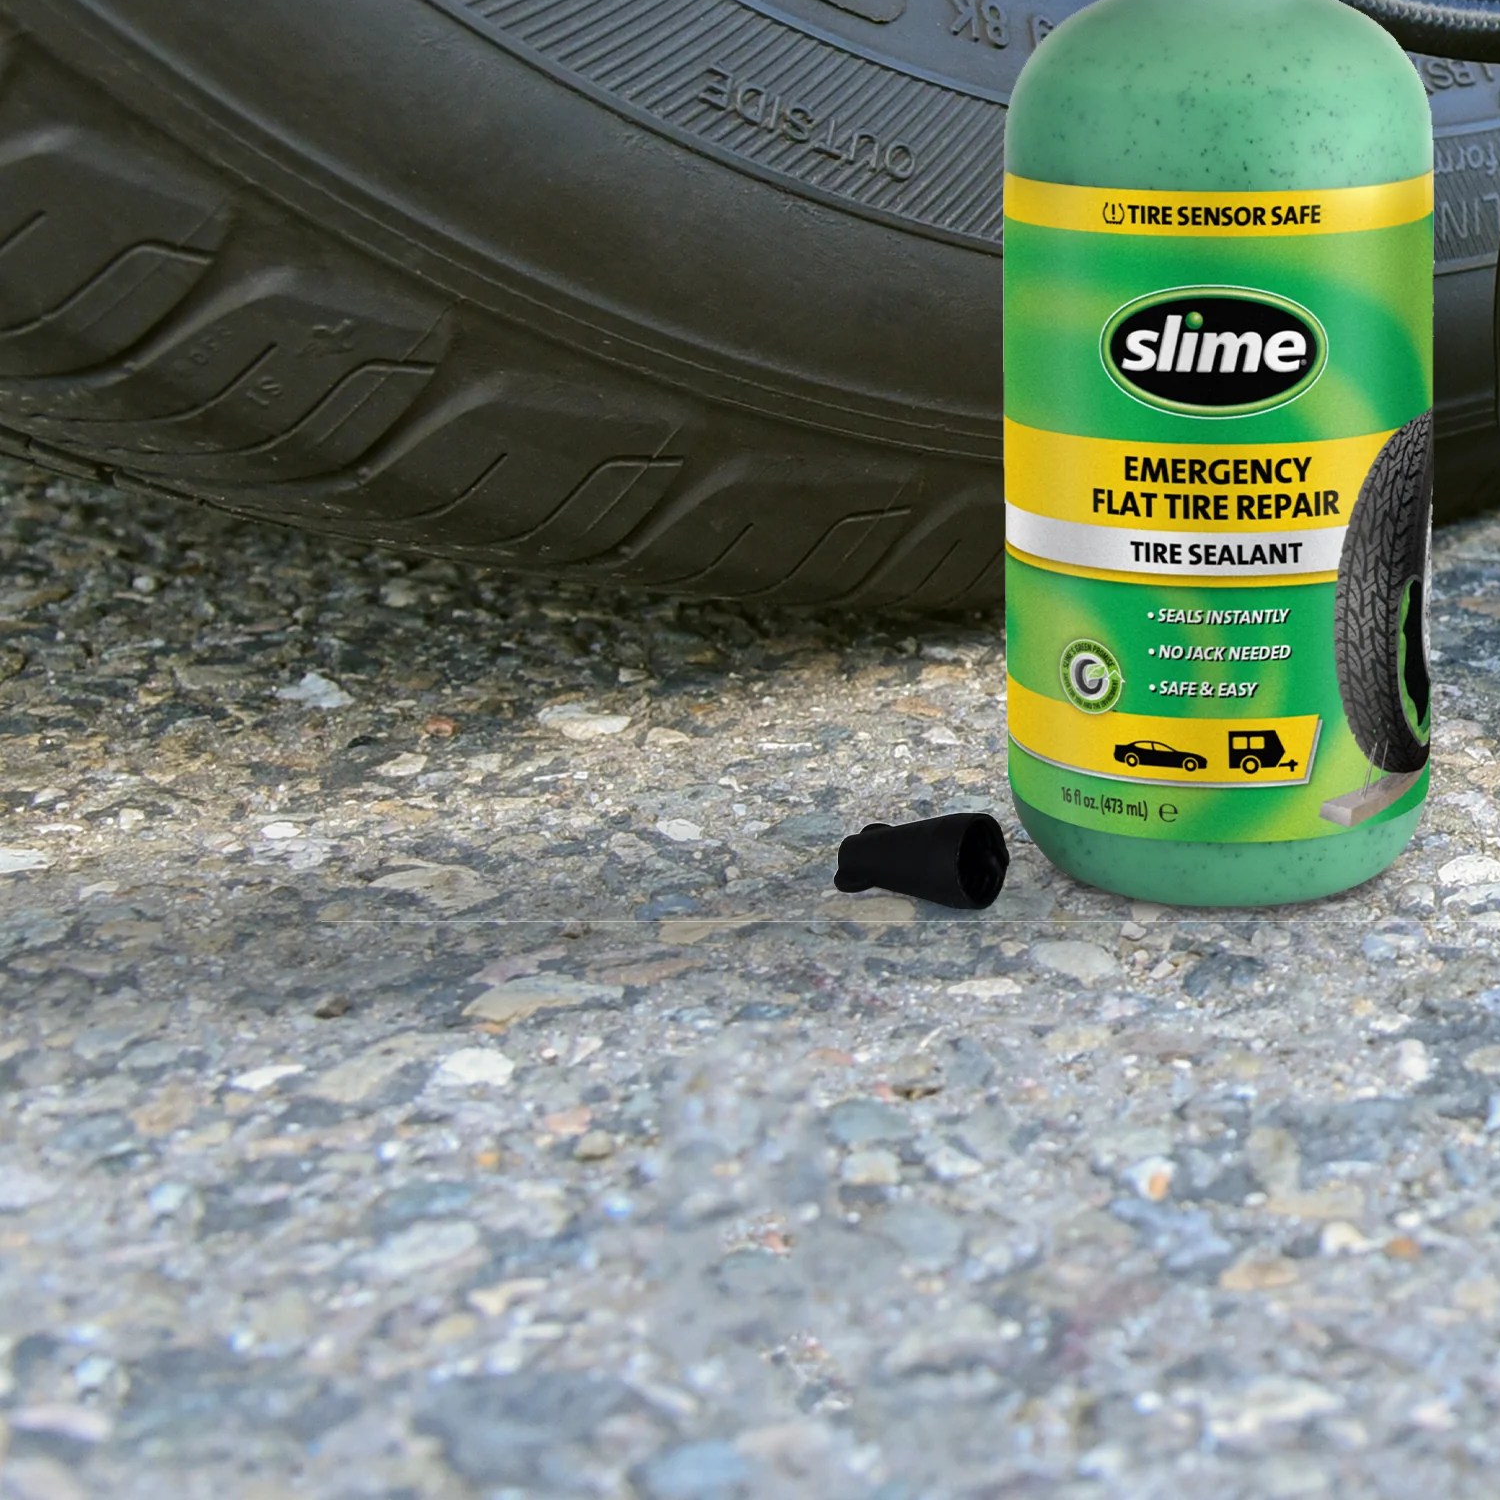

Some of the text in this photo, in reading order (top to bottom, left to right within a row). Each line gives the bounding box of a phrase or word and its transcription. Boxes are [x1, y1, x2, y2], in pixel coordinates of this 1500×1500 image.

[699, 64, 917, 181] OUTSIDE
[1127, 204, 1322, 227] TIRE SENSOR SAFE
[1121, 311, 1307, 373] slime
[1124, 456, 1312, 485] EMERGENCY
[1092, 488, 1341, 520] FLAT TIRE REPAIR
[1130, 541, 1303, 566] TIRE SEALANT
[1157, 608, 1291, 626] SEALS INSTANTLY
[1158, 644, 1292, 662] NO JACK NEEDED
[1159, 681, 1258, 698] SAFE & EASY
[1061, 787, 1072, 803] 16
[1074, 789, 1081, 806] fl
[1084, 796, 1099, 810] oz.
[1101, 794, 1123, 815] (473
[1126, 800, 1148, 821] mL)
